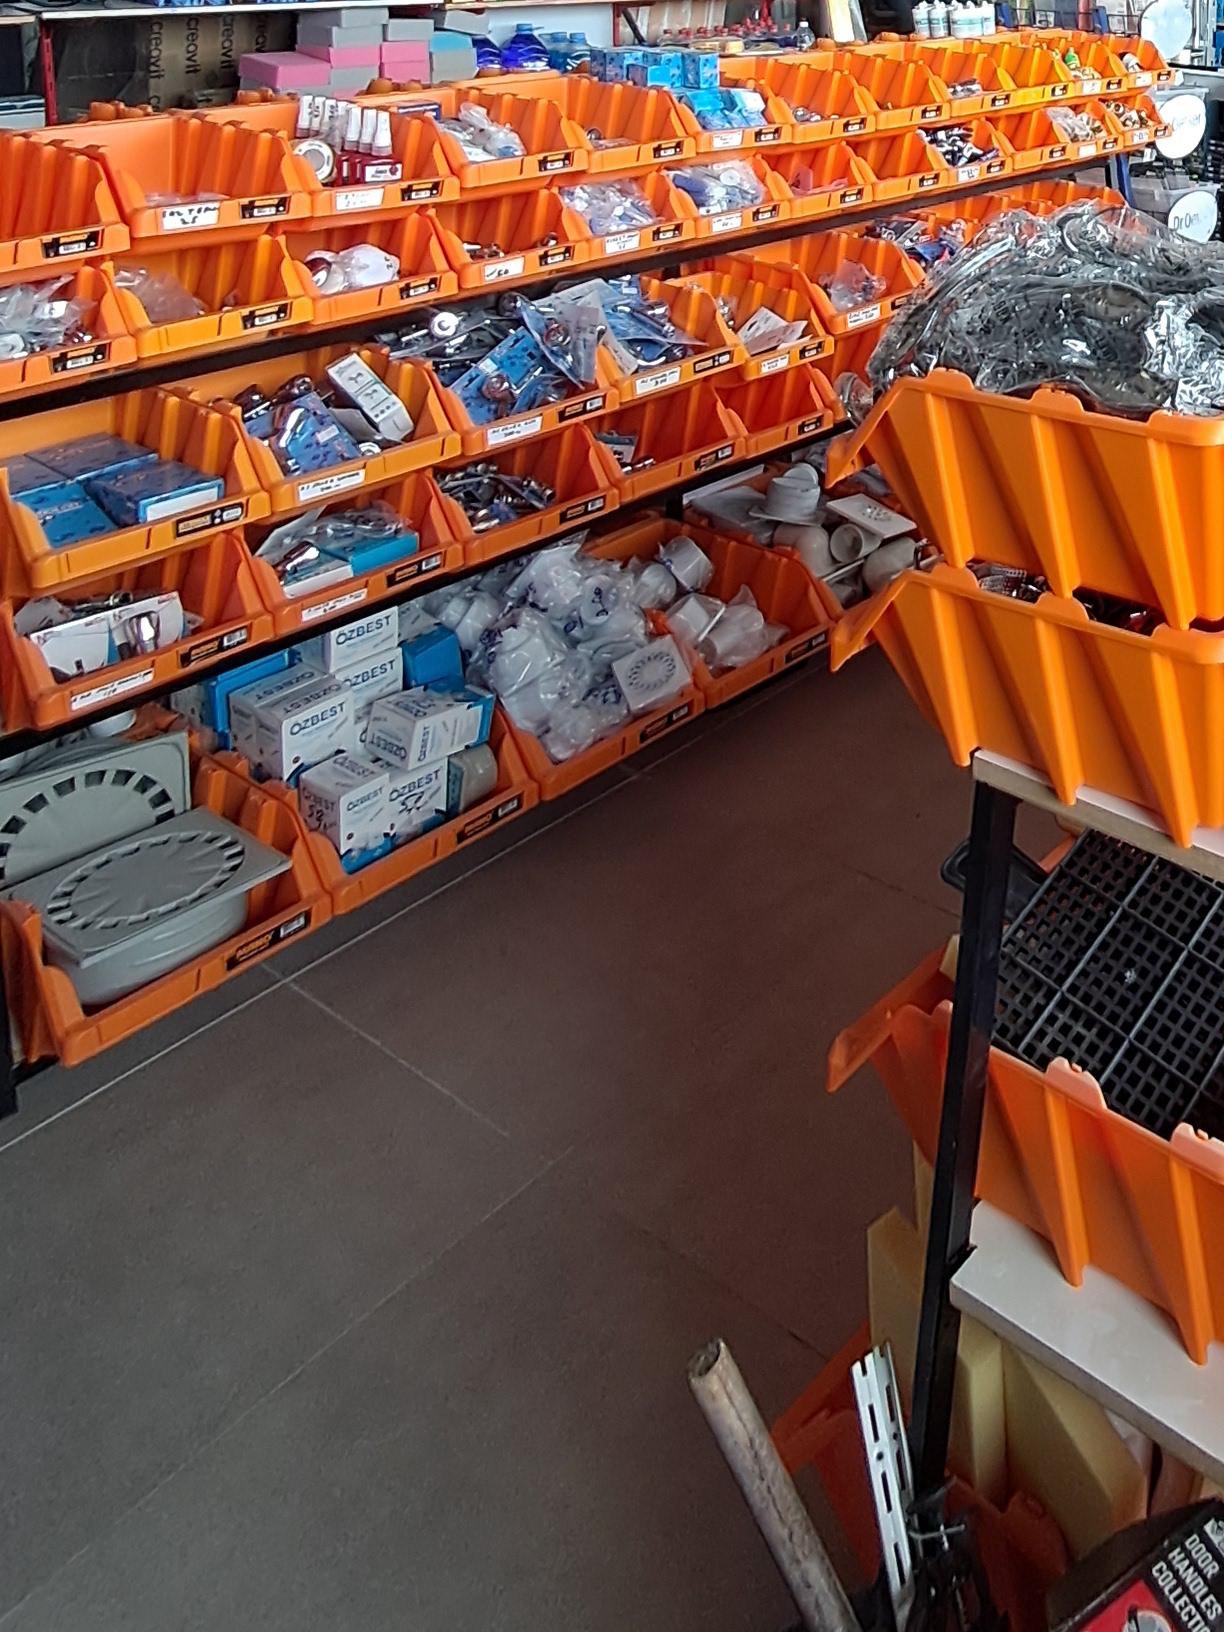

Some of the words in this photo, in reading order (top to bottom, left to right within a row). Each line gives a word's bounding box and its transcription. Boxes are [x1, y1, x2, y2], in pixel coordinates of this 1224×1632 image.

[149, 21, 165, 80] creavit
[186, 18, 201, 75] creavit
[1168, 1546, 1223, 1621] HANDLES
[1184, 1533, 1220, 1580] DOOR
